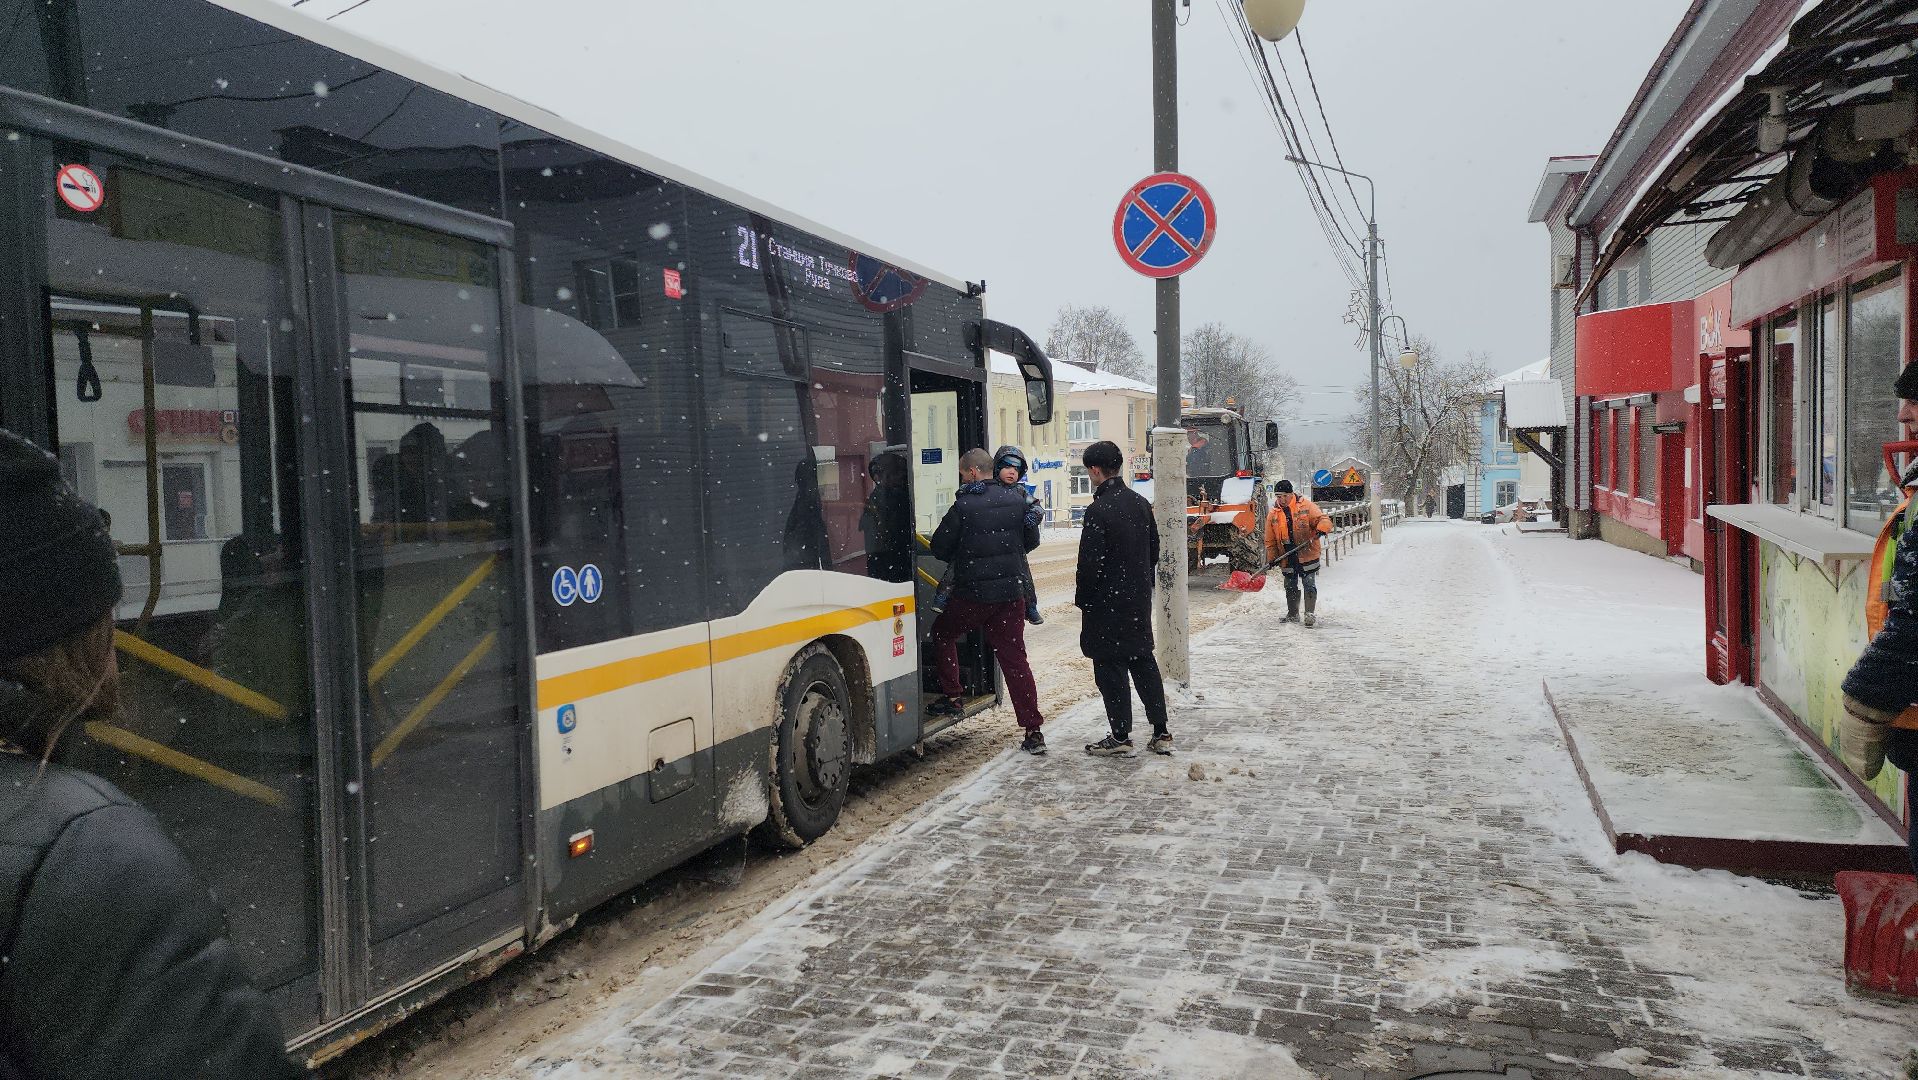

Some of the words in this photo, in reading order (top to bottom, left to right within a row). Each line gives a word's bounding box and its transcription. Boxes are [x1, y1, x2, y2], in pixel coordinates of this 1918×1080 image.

[737, 225, 759, 270] 21
[768, 236, 815, 269] Станция
[805, 267, 831, 290] Руза
